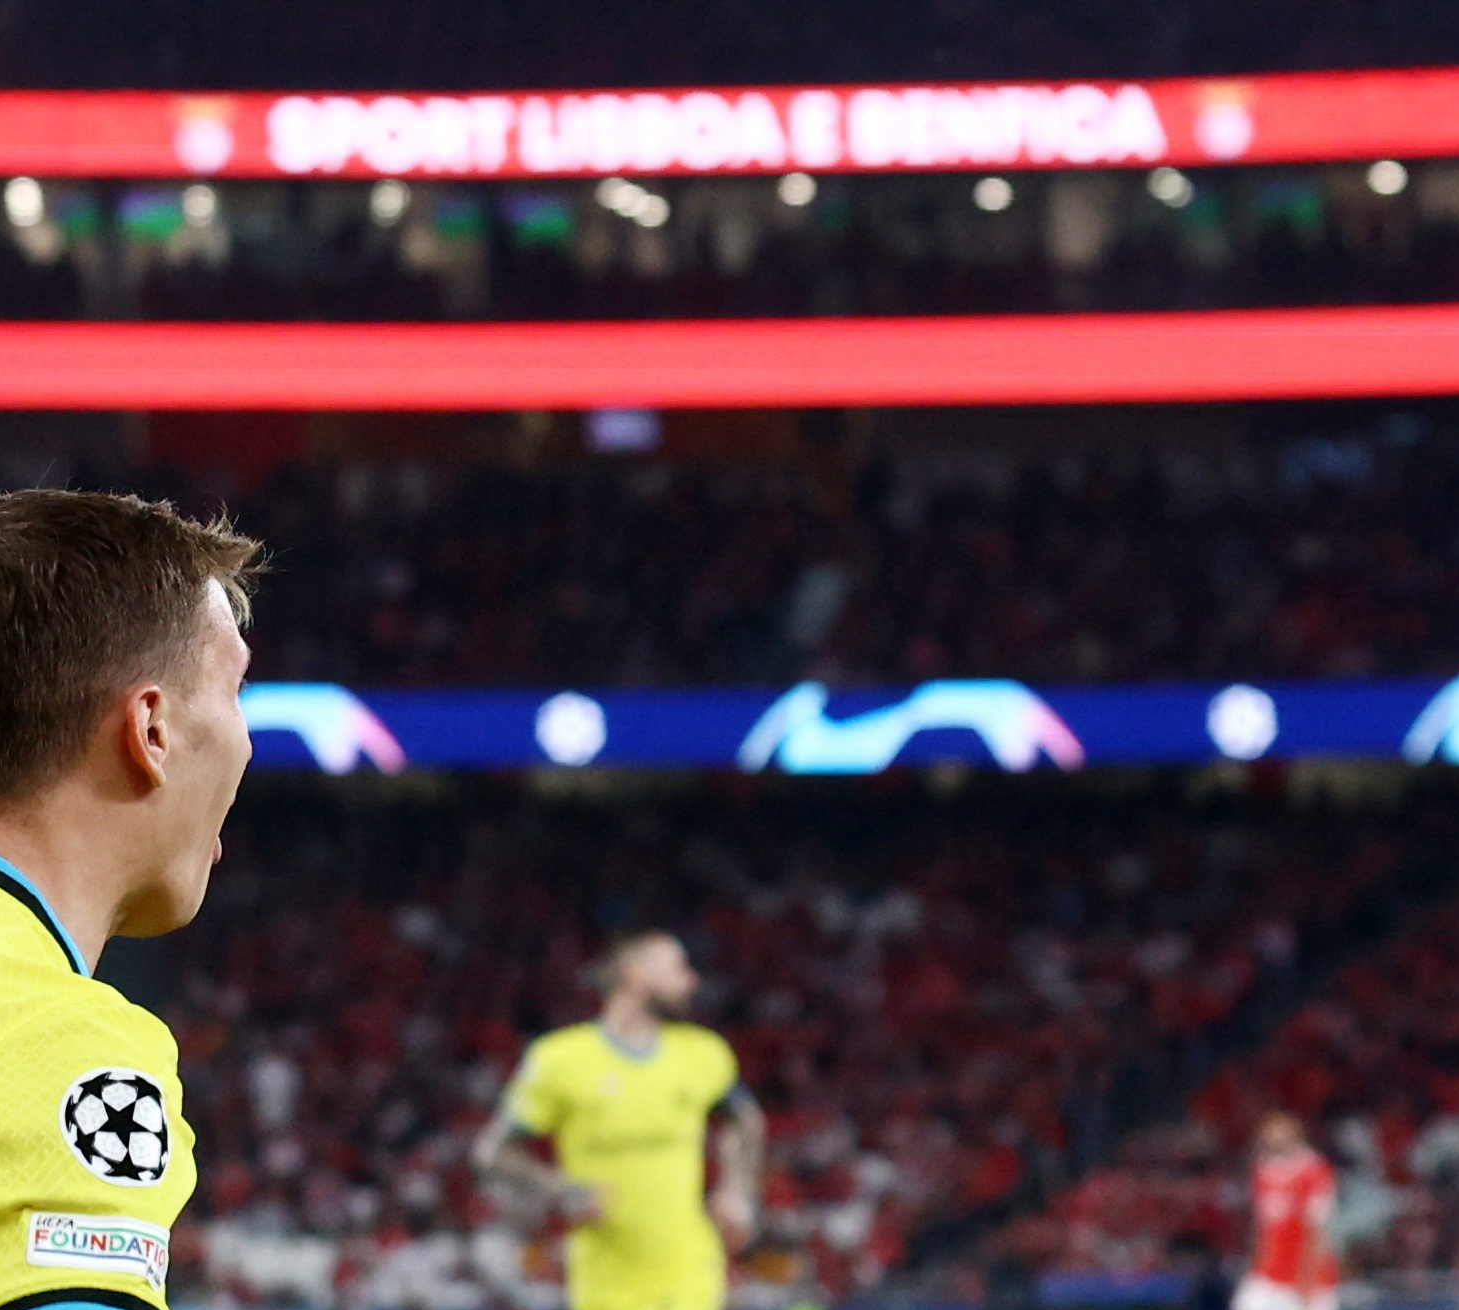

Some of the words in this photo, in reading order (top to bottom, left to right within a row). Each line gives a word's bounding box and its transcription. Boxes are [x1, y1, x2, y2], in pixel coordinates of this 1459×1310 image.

[266, 96, 516, 174] SPORT
[518, 92, 785, 171] LISBOA
[845, 84, 1168, 165] BENFICA
[36, 1214, 75, 1229] UEFA
